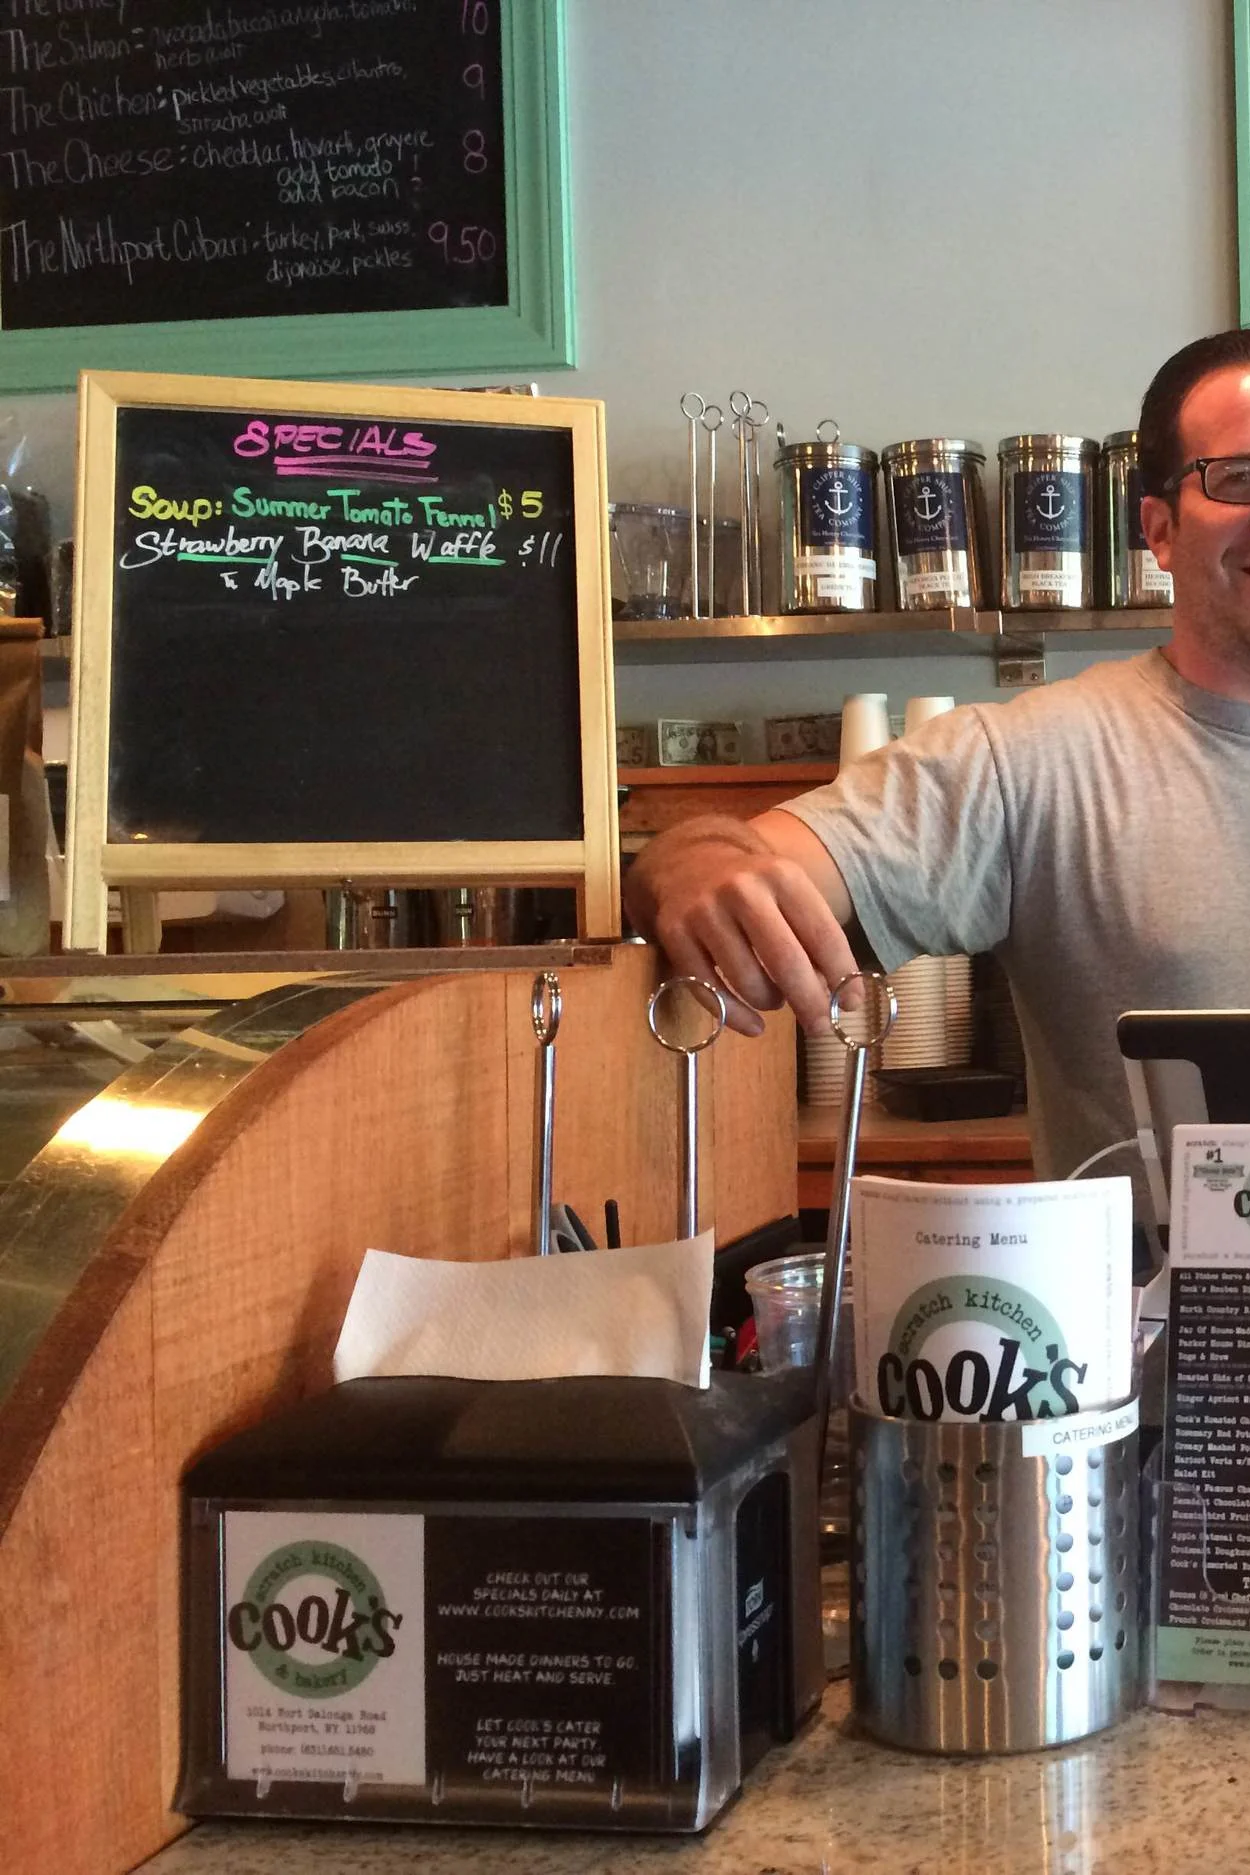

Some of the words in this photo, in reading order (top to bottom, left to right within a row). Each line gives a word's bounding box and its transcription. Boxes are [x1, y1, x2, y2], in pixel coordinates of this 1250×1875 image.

[462, 0, 488, 34] 10
[462, 64, 486, 100] 9
[0, 87, 57, 135] The
[462, 130, 489, 173] 8
[2, 149, 63, 190] The
[277, 162, 320, 190] add
[278, 182, 321, 204] add
[0, 221, 59, 282] The
[428, 222, 496, 263] 9.50
[233, 420, 437, 458] SPECIALS
[129, 485, 223, 527] Soup:
[231, 487, 332, 521] Summer
[326, 488, 413, 526] Tomato
[418, 494, 496, 530] Fennel
[119, 531, 285, 569] Strawberry
[291, 526, 390, 567] Banana
[1206, 1148, 1223, 1163] #1
[915, 1232, 981, 1249] Catering
[990, 1232, 1028, 1246] Menu
[965, 1289, 1043, 1342] kitchen
[1053, 1423, 1112, 1445] CATERING
[486, 1572, 529, 1585] CHECK
[535, 1572, 561, 1585] OUT
[565, 1572, 589, 1586] OUR
[474, 1588, 537, 1601] SPECIALS
[542, 1588, 579, 1602] DAILY
[583, 1589, 604, 1602] AT
[437, 1653, 480, 1666] HOUSE
[485, 1653, 525, 1667] MADE
[529, 1653, 590, 1668] DINNERS
[594, 1655, 613, 1669] TO
[455, 1669, 488, 1683] JUST
[493, 1669, 532, 1684] HEAT
[535, 1671, 565, 1685] AND
[476, 1718, 503, 1732] LET
[556, 1719, 601, 1734] CATER
[476, 1735, 508, 1748] YOUR
[511, 1736, 549, 1749] NEXT
[467, 1752, 504, 1765] HAVE
[508, 1752, 518, 1765] A
[522, 1753, 554, 1766] LOOK
[558, 1753, 576, 1766] AT
[581, 1754, 607, 1767] OUR
[555, 1769, 595, 1783] MENU
